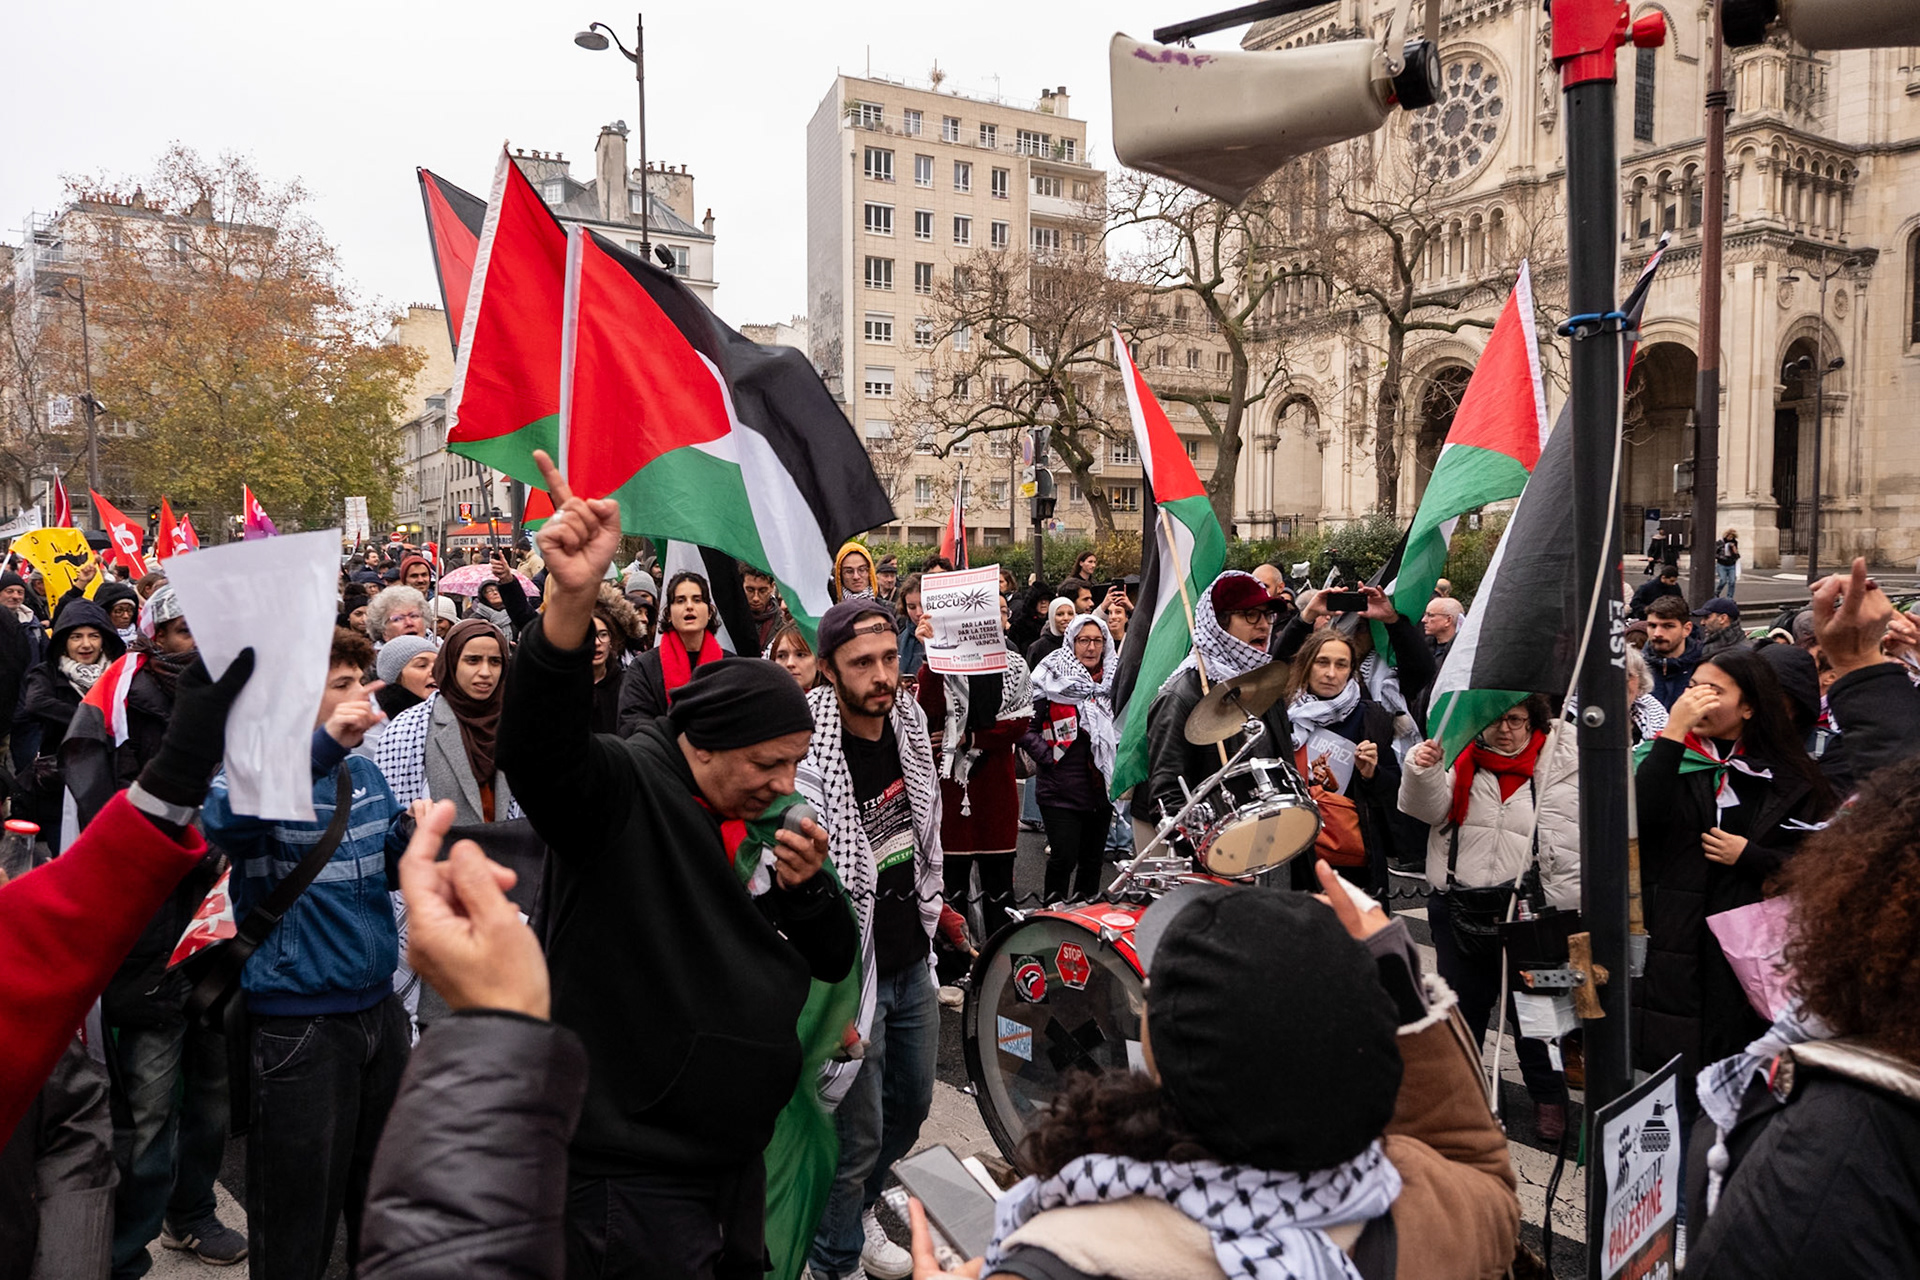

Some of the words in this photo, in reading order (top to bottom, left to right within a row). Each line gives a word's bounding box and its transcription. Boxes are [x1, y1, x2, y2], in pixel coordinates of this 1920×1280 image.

[926, 592, 959, 602] BRISONS
[926, 598, 967, 611] BLOCUS
[984, 619, 996, 627] MER
[969, 633, 999, 641] PALESTINE
[1309, 735, 1353, 766] LIBÉREZ
[1063, 946, 1082, 961] STOP
[1609, 1178, 1663, 1270] PALESTINE
